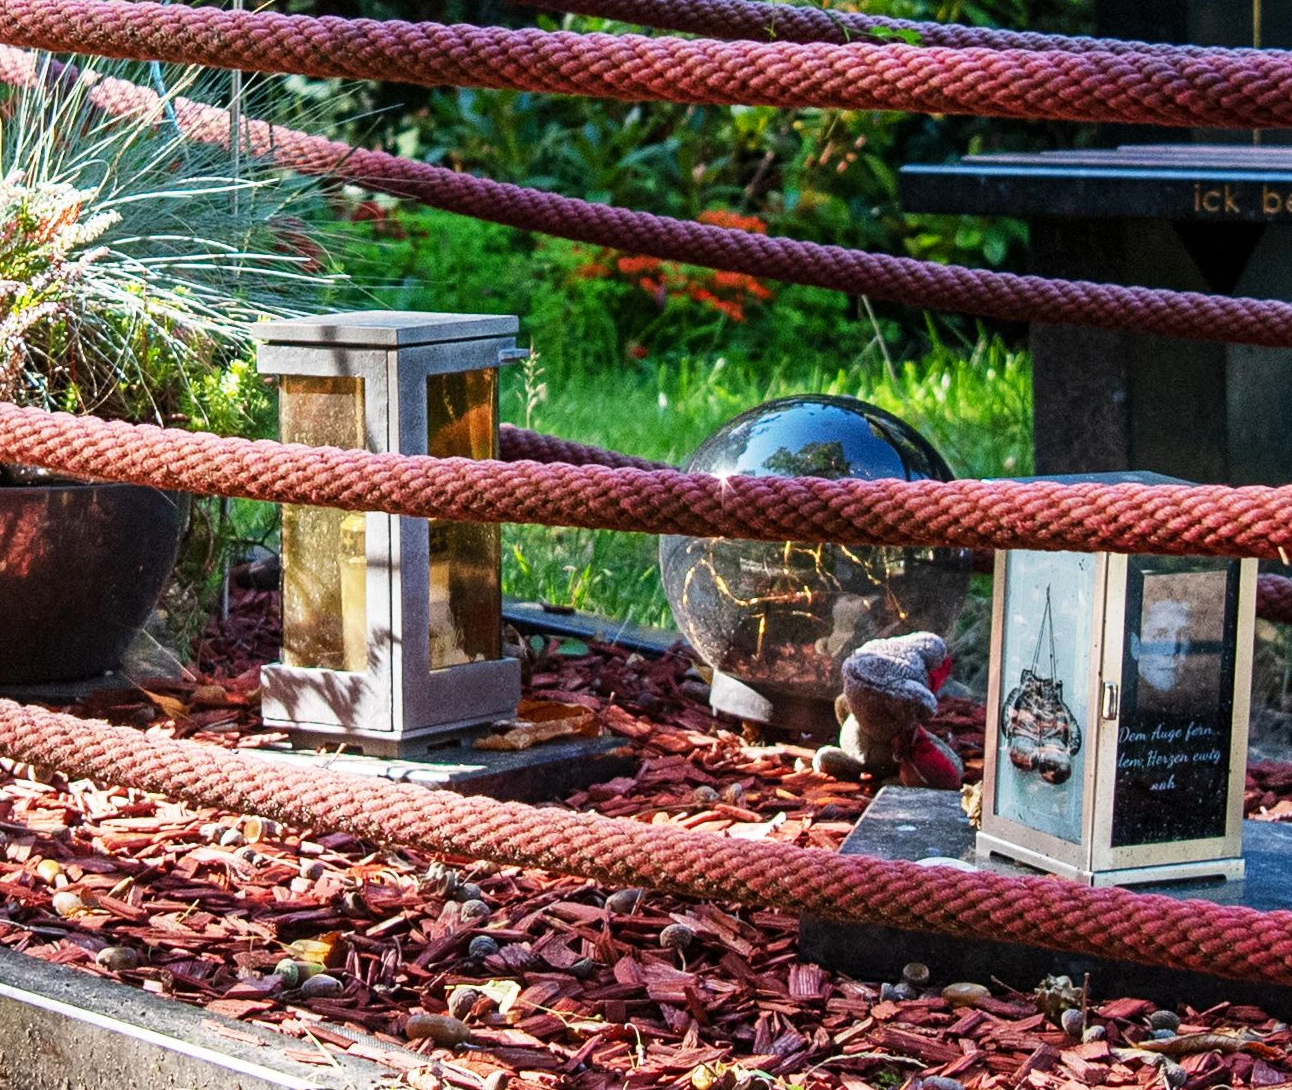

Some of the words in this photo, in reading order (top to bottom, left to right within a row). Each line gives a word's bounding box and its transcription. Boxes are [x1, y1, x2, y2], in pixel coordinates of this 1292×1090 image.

[1193, 183, 1240, 213] ick
[1118, 725, 1147, 743] Dem
[1151, 723, 1182, 743] Auge
[1146, 749, 1188, 769] Herzen
[1193, 748, 1221, 764] ewig
